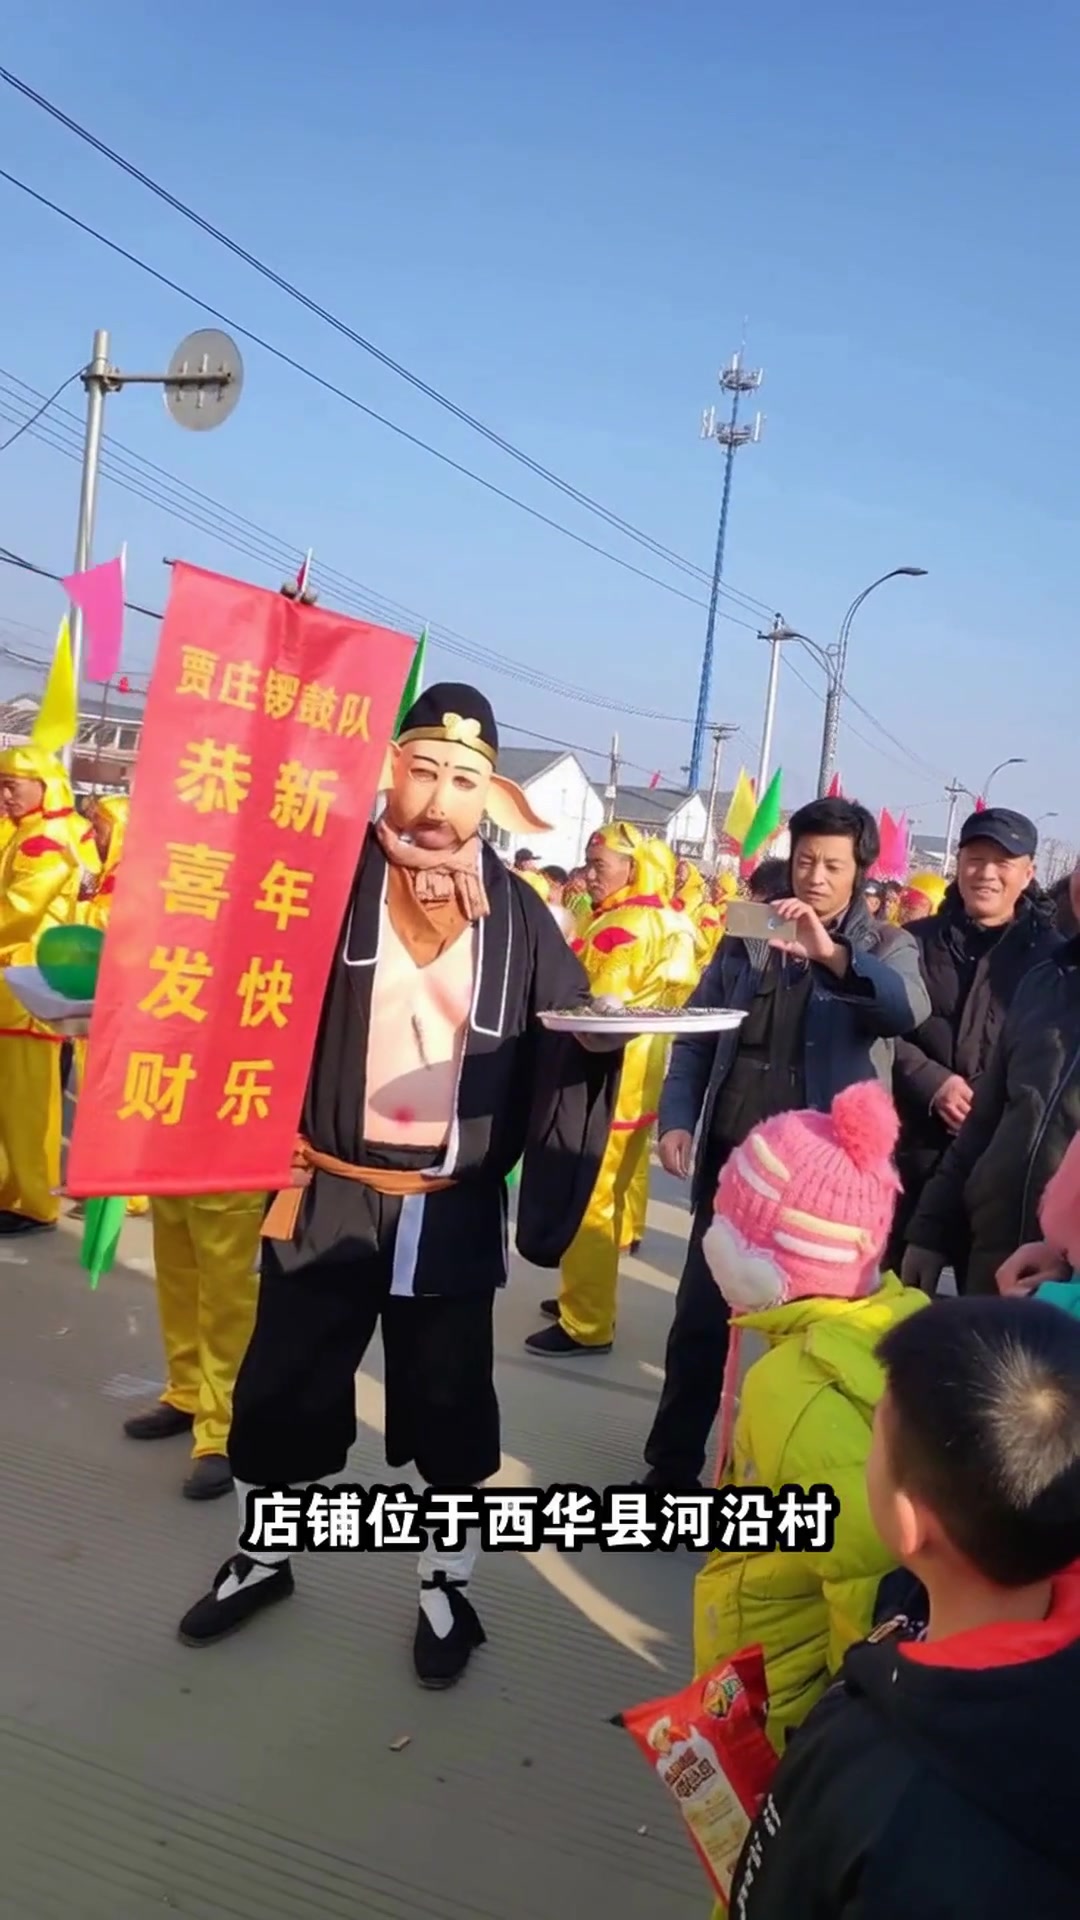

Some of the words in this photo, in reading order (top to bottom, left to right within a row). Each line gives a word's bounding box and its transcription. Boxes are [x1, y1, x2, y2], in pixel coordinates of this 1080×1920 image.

[176, 645, 371, 742] 贾庄锣鼓队
[117, 738, 253, 1125] 恭喜发财
[216, 761, 338, 1126] 新年快乐
